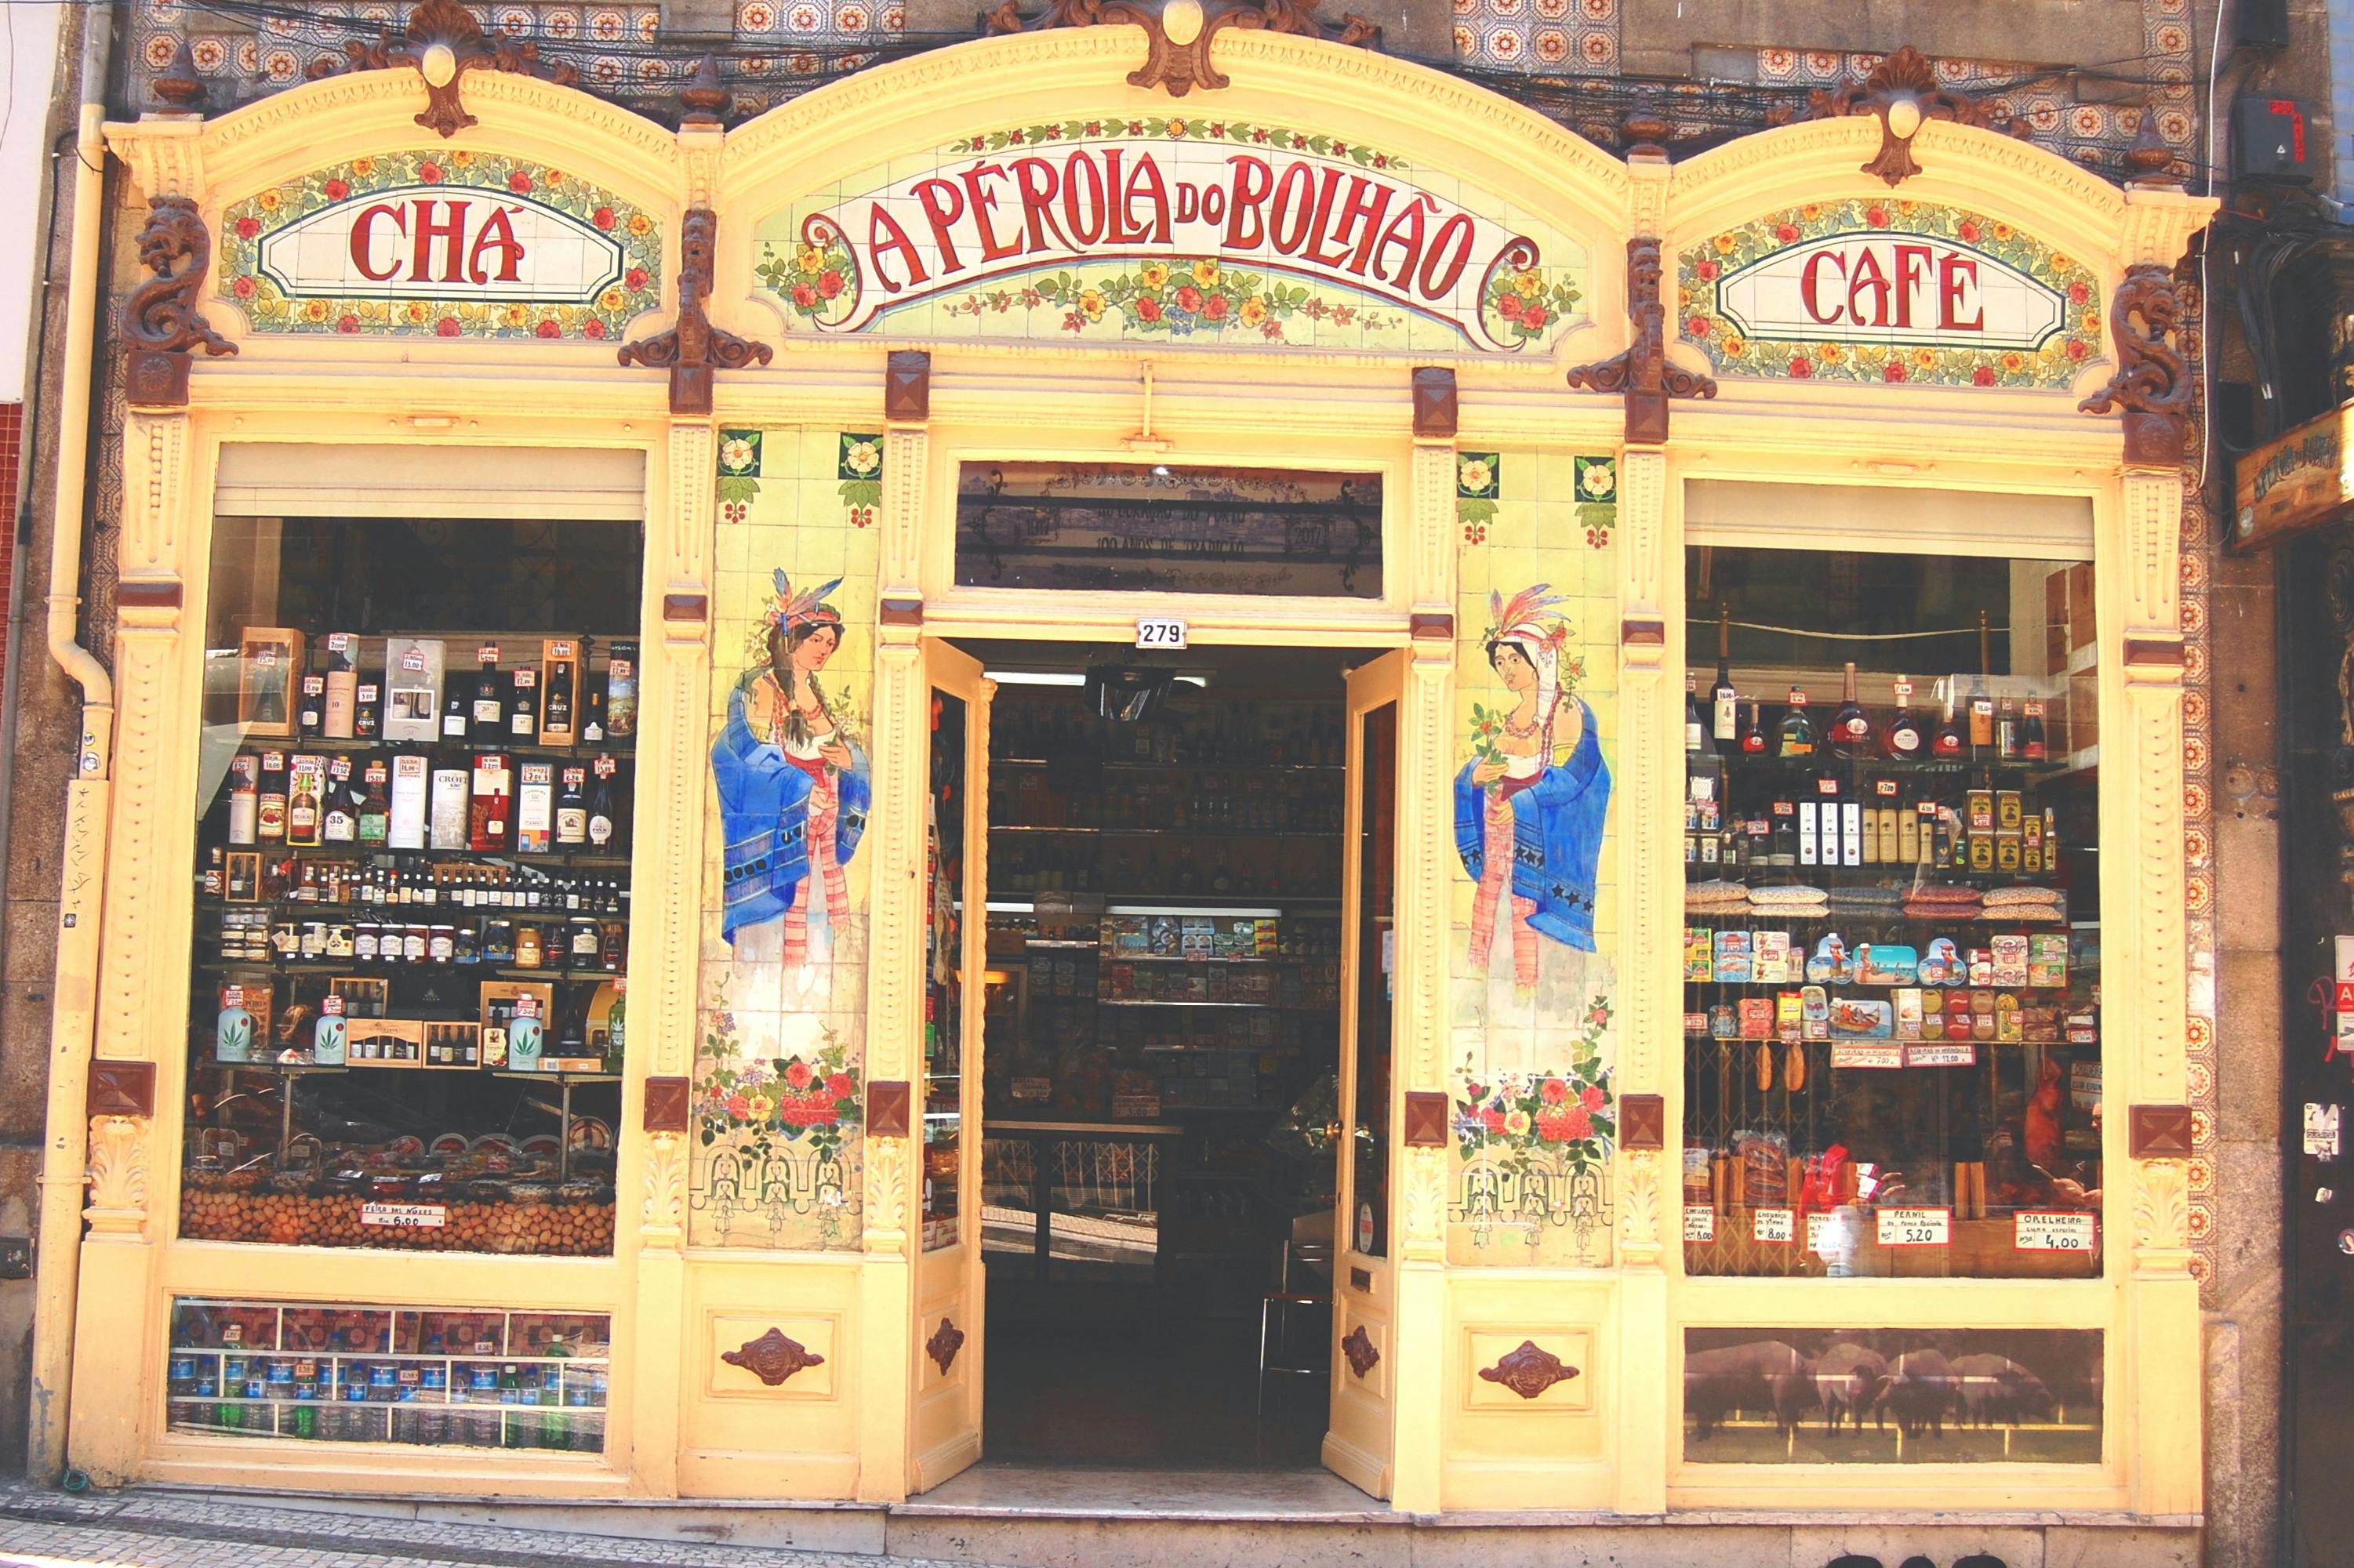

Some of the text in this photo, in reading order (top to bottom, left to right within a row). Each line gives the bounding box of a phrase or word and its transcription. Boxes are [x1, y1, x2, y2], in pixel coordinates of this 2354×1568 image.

[870, 148, 1475, 299] A PÉROLA DO BOLHÃO
[351, 200, 525, 285] CHÁ
[1801, 245, 1983, 332] CAFÉ
[1143, 625, 1179, 643] 279
[438, 775, 468, 784] CROFT
[329, 815, 343, 825] 35
[393, 1216, 419, 1225] 6.00
[2024, 1214, 2082, 1225] ORELHEIRA
[1767, 1228, 1785, 1240] 8.00
[1905, 1229, 1932, 1243] 5.20
[2045, 1234, 2079, 1249] 4.00
